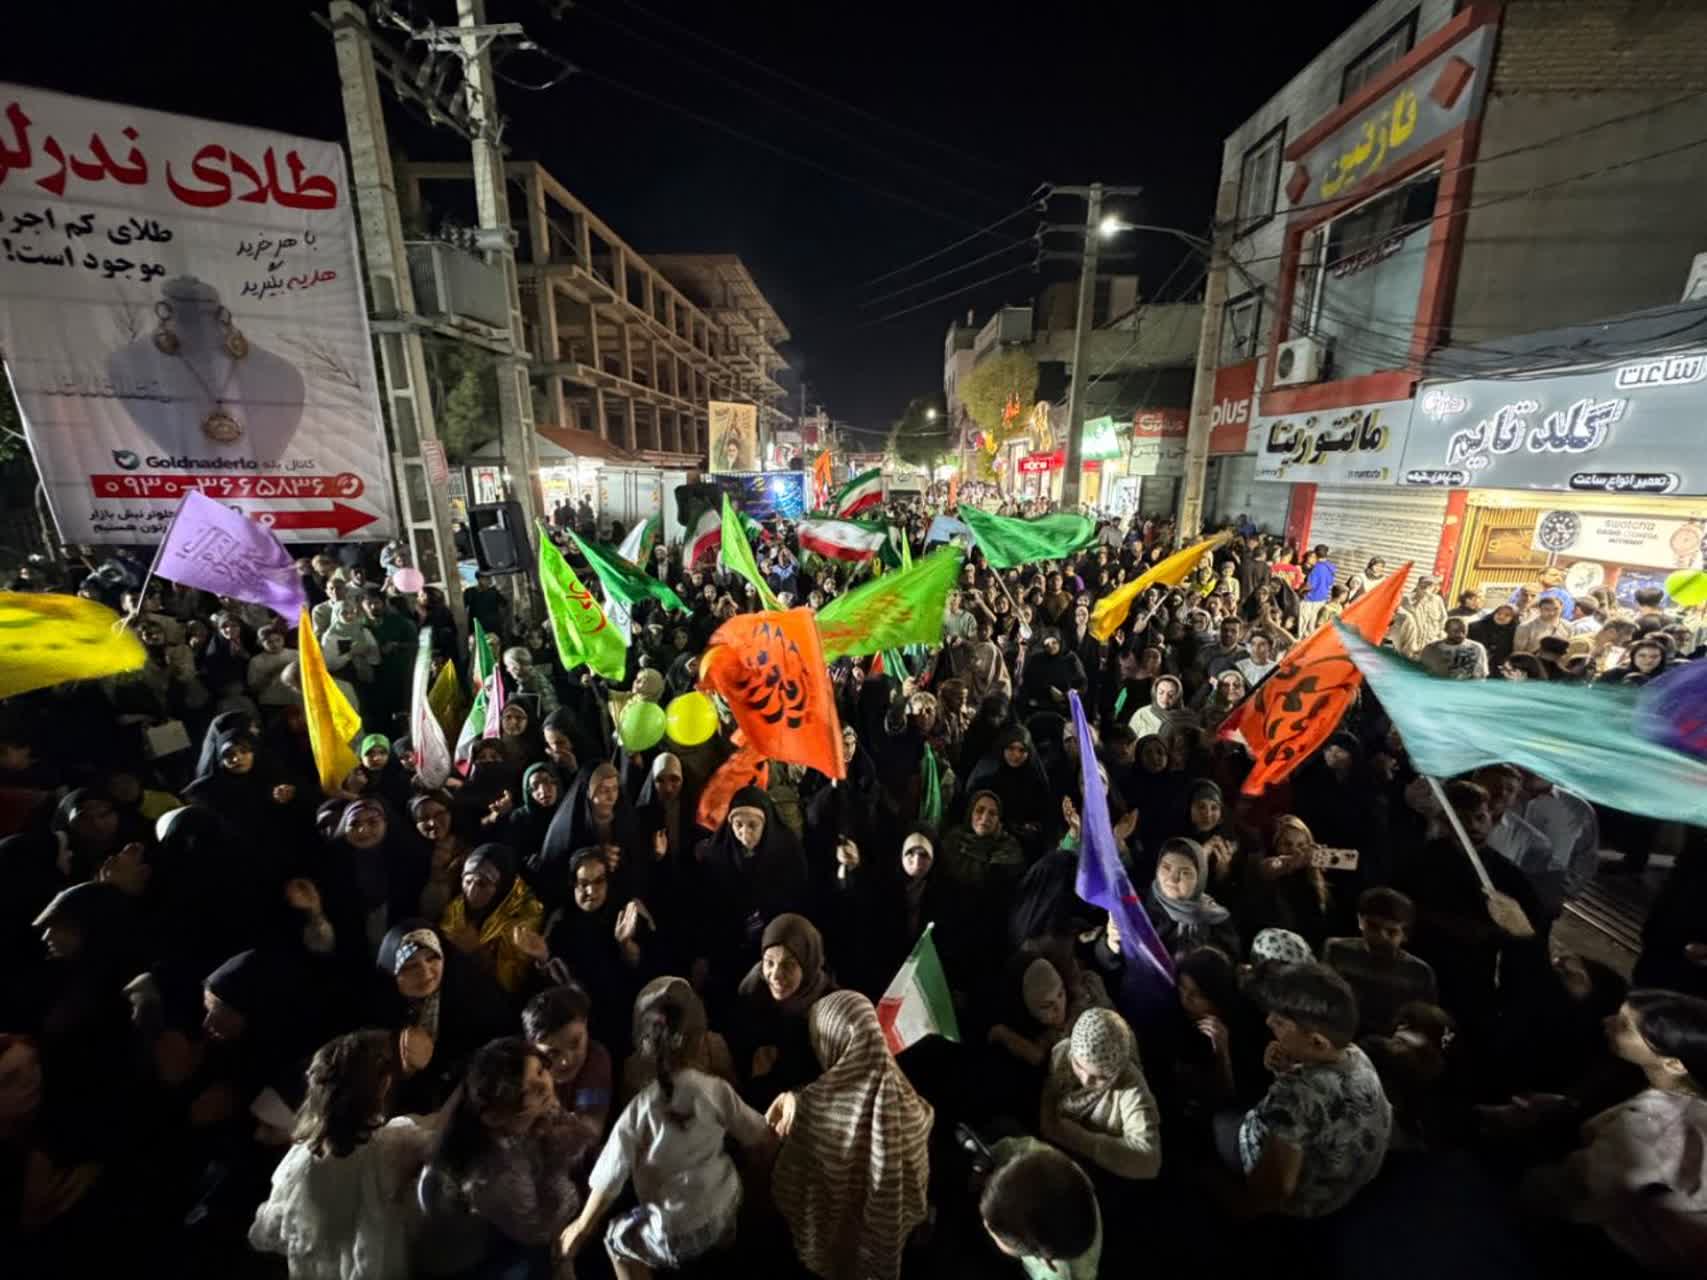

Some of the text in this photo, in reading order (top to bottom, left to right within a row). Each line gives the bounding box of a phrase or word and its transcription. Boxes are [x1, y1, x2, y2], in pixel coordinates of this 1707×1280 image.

[0, 102, 337, 209] طلای ندرل
[0, 208, 173, 245] طلای کم اجر
[236, 230, 316, 260] با هر خرید
[3, 238, 165, 282] موجود است!
[287, 270, 336, 290] هدیه
[1617, 355, 1703, 389] ساعت
[1309, 409, 1390, 465] مانتو
[1445, 399, 1538, 468] تایم
[1527, 398, 1630, 452] گلد
[1573, 474, 1606, 485] ساعت
[1605, 474, 1634, 490] انواع
